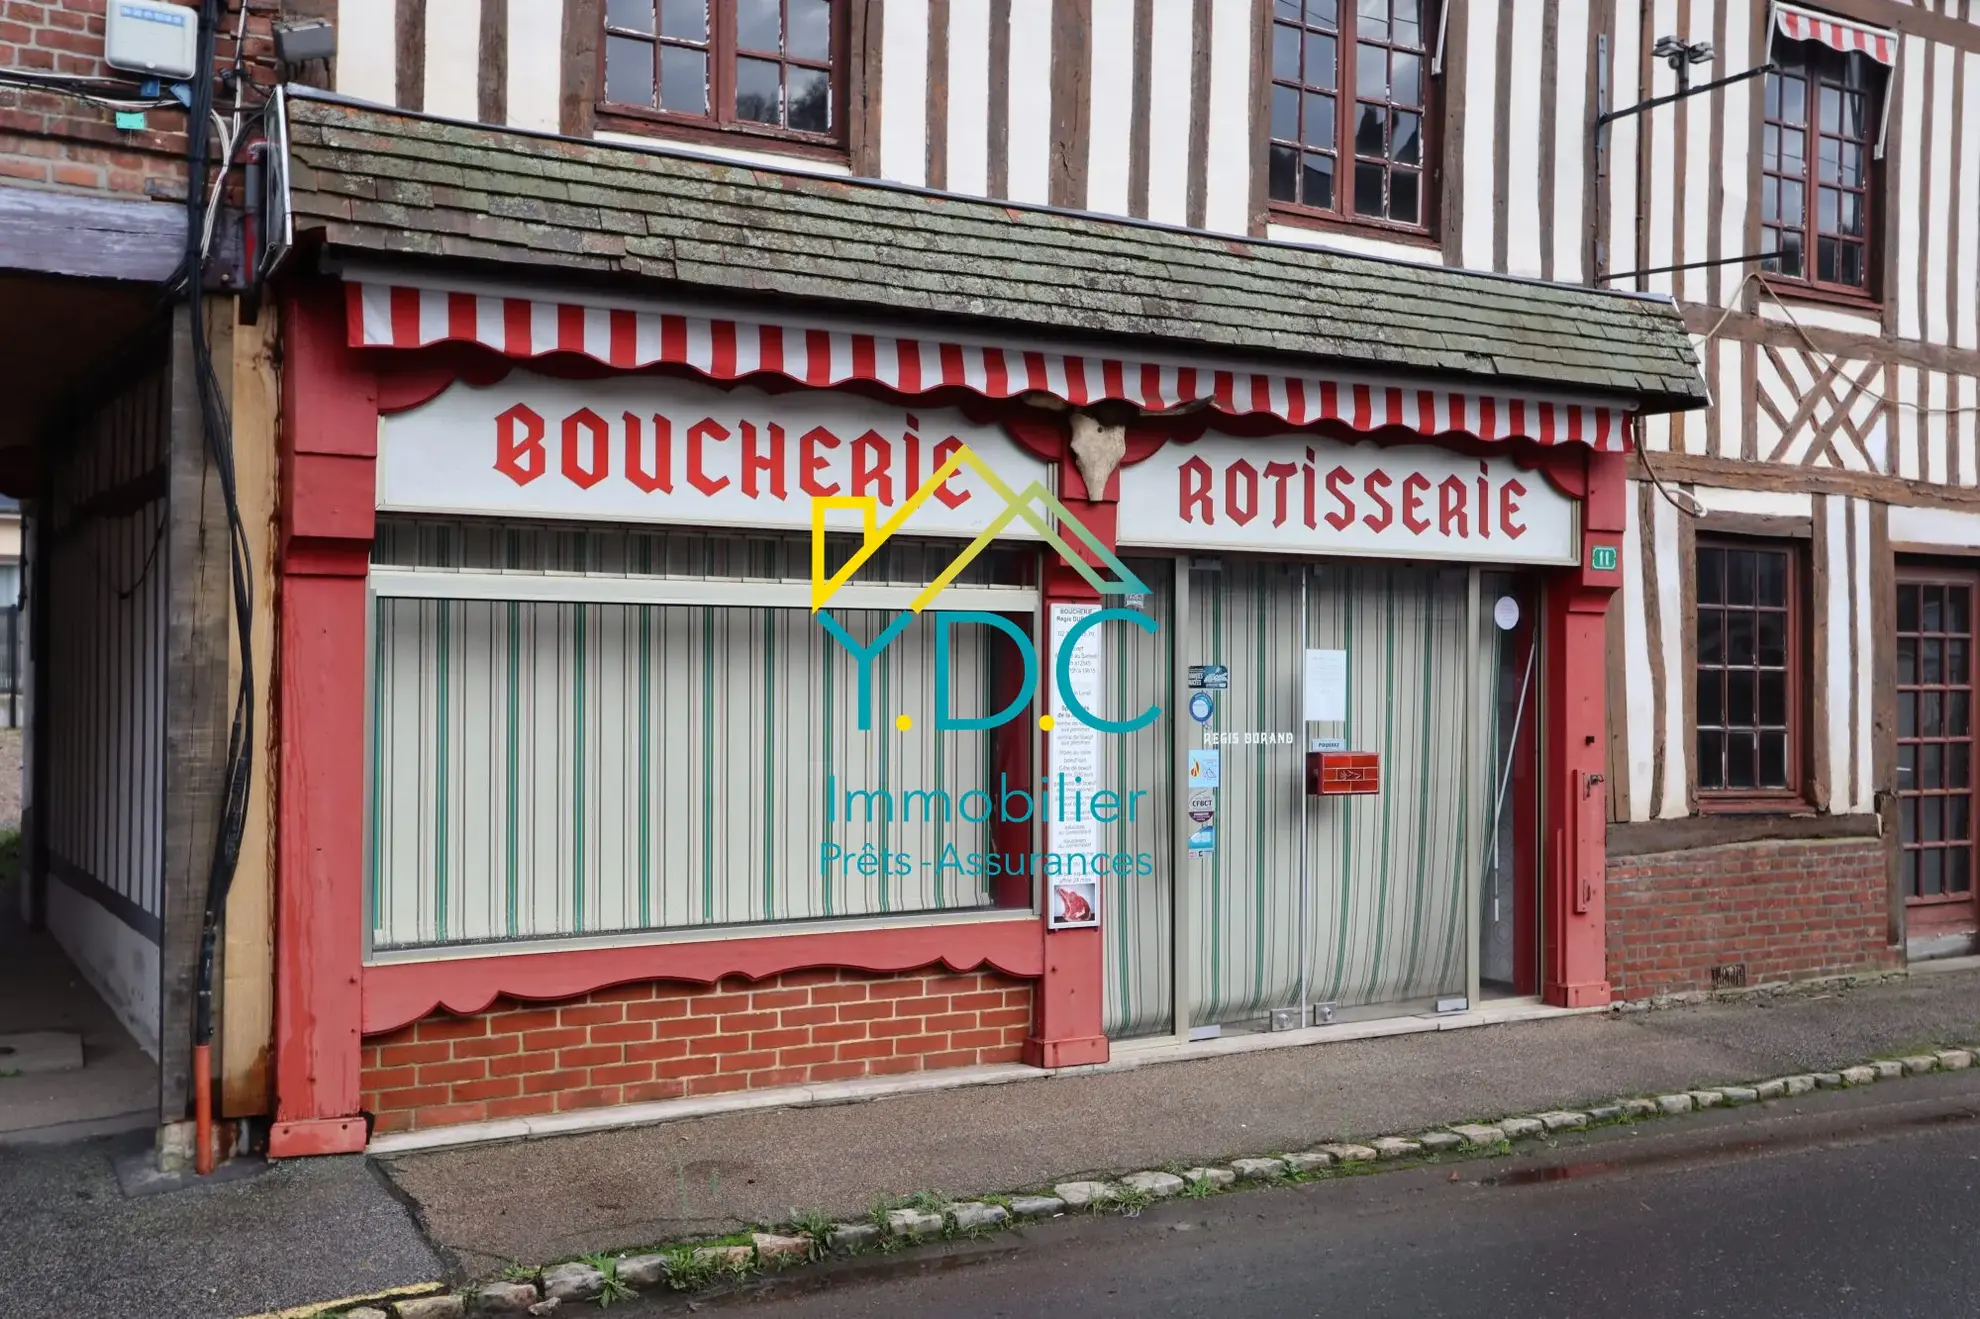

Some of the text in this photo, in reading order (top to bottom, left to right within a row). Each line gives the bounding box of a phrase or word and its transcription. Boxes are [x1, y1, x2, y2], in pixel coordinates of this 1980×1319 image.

[493, 402, 972, 510] BOUCHERIE
[1178, 446, 1527, 540] ROTISSERIE
[1600, 550, 1609, 566] 11
[1203, 732, 1294, 746] REGIS DURAND
